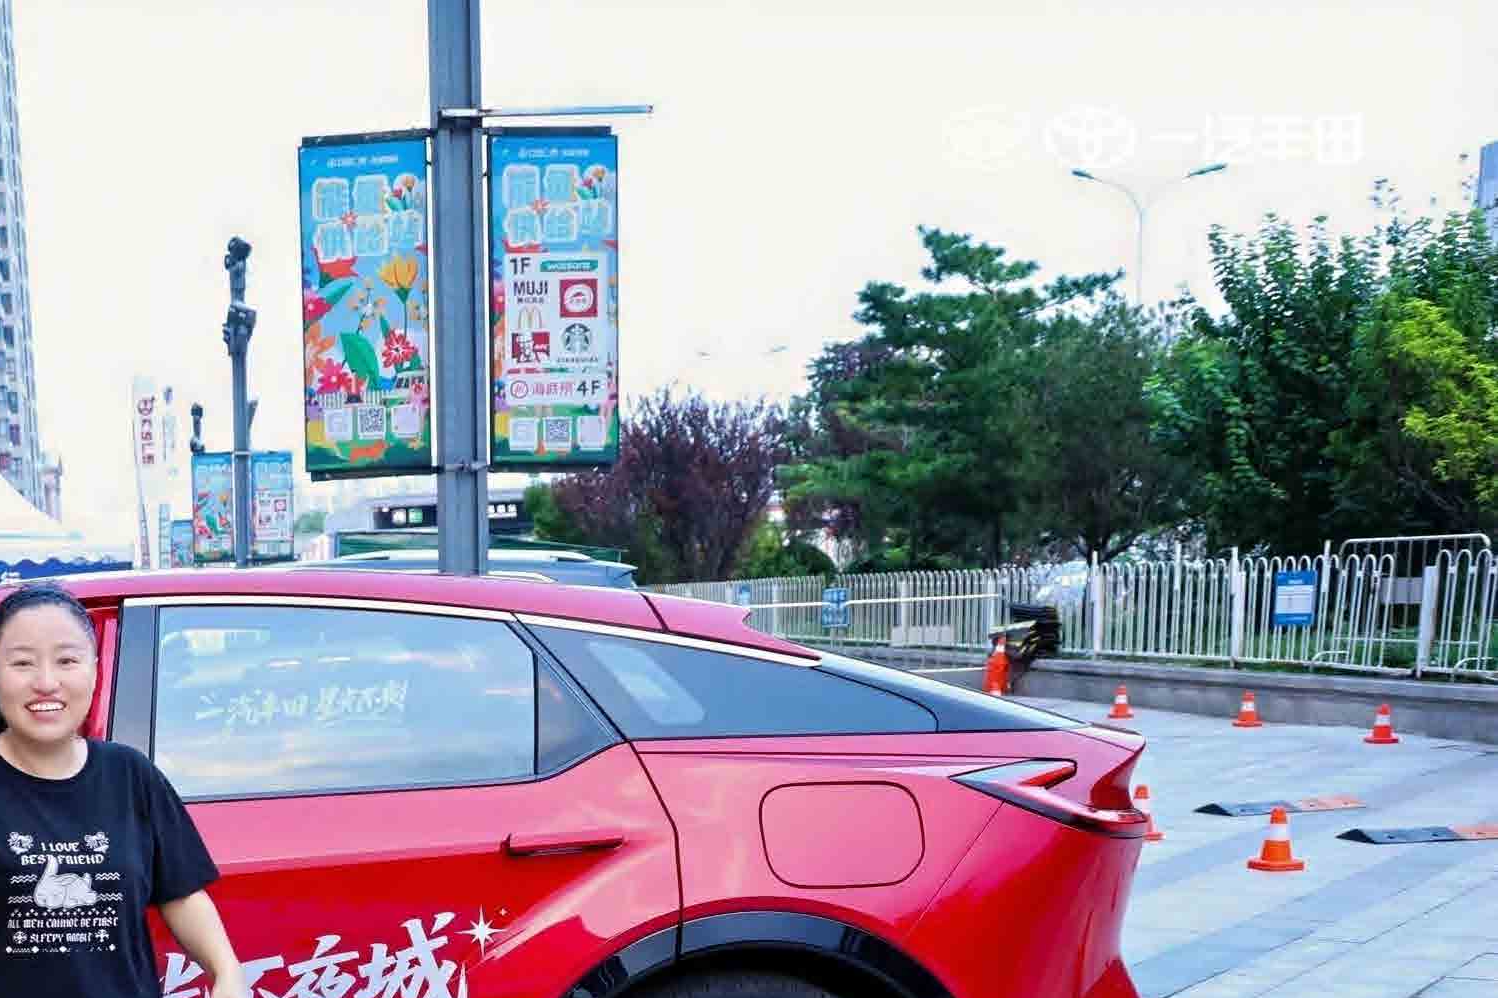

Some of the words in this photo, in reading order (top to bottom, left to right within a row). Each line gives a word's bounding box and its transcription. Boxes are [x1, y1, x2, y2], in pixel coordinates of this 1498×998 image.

[510, 257, 531, 275] 1F
[513, 280, 549, 297] MUJI
[577, 380, 601, 397] 4F
[49, 841, 81, 852] LOVE
[56, 853, 105, 865] FRIEND
